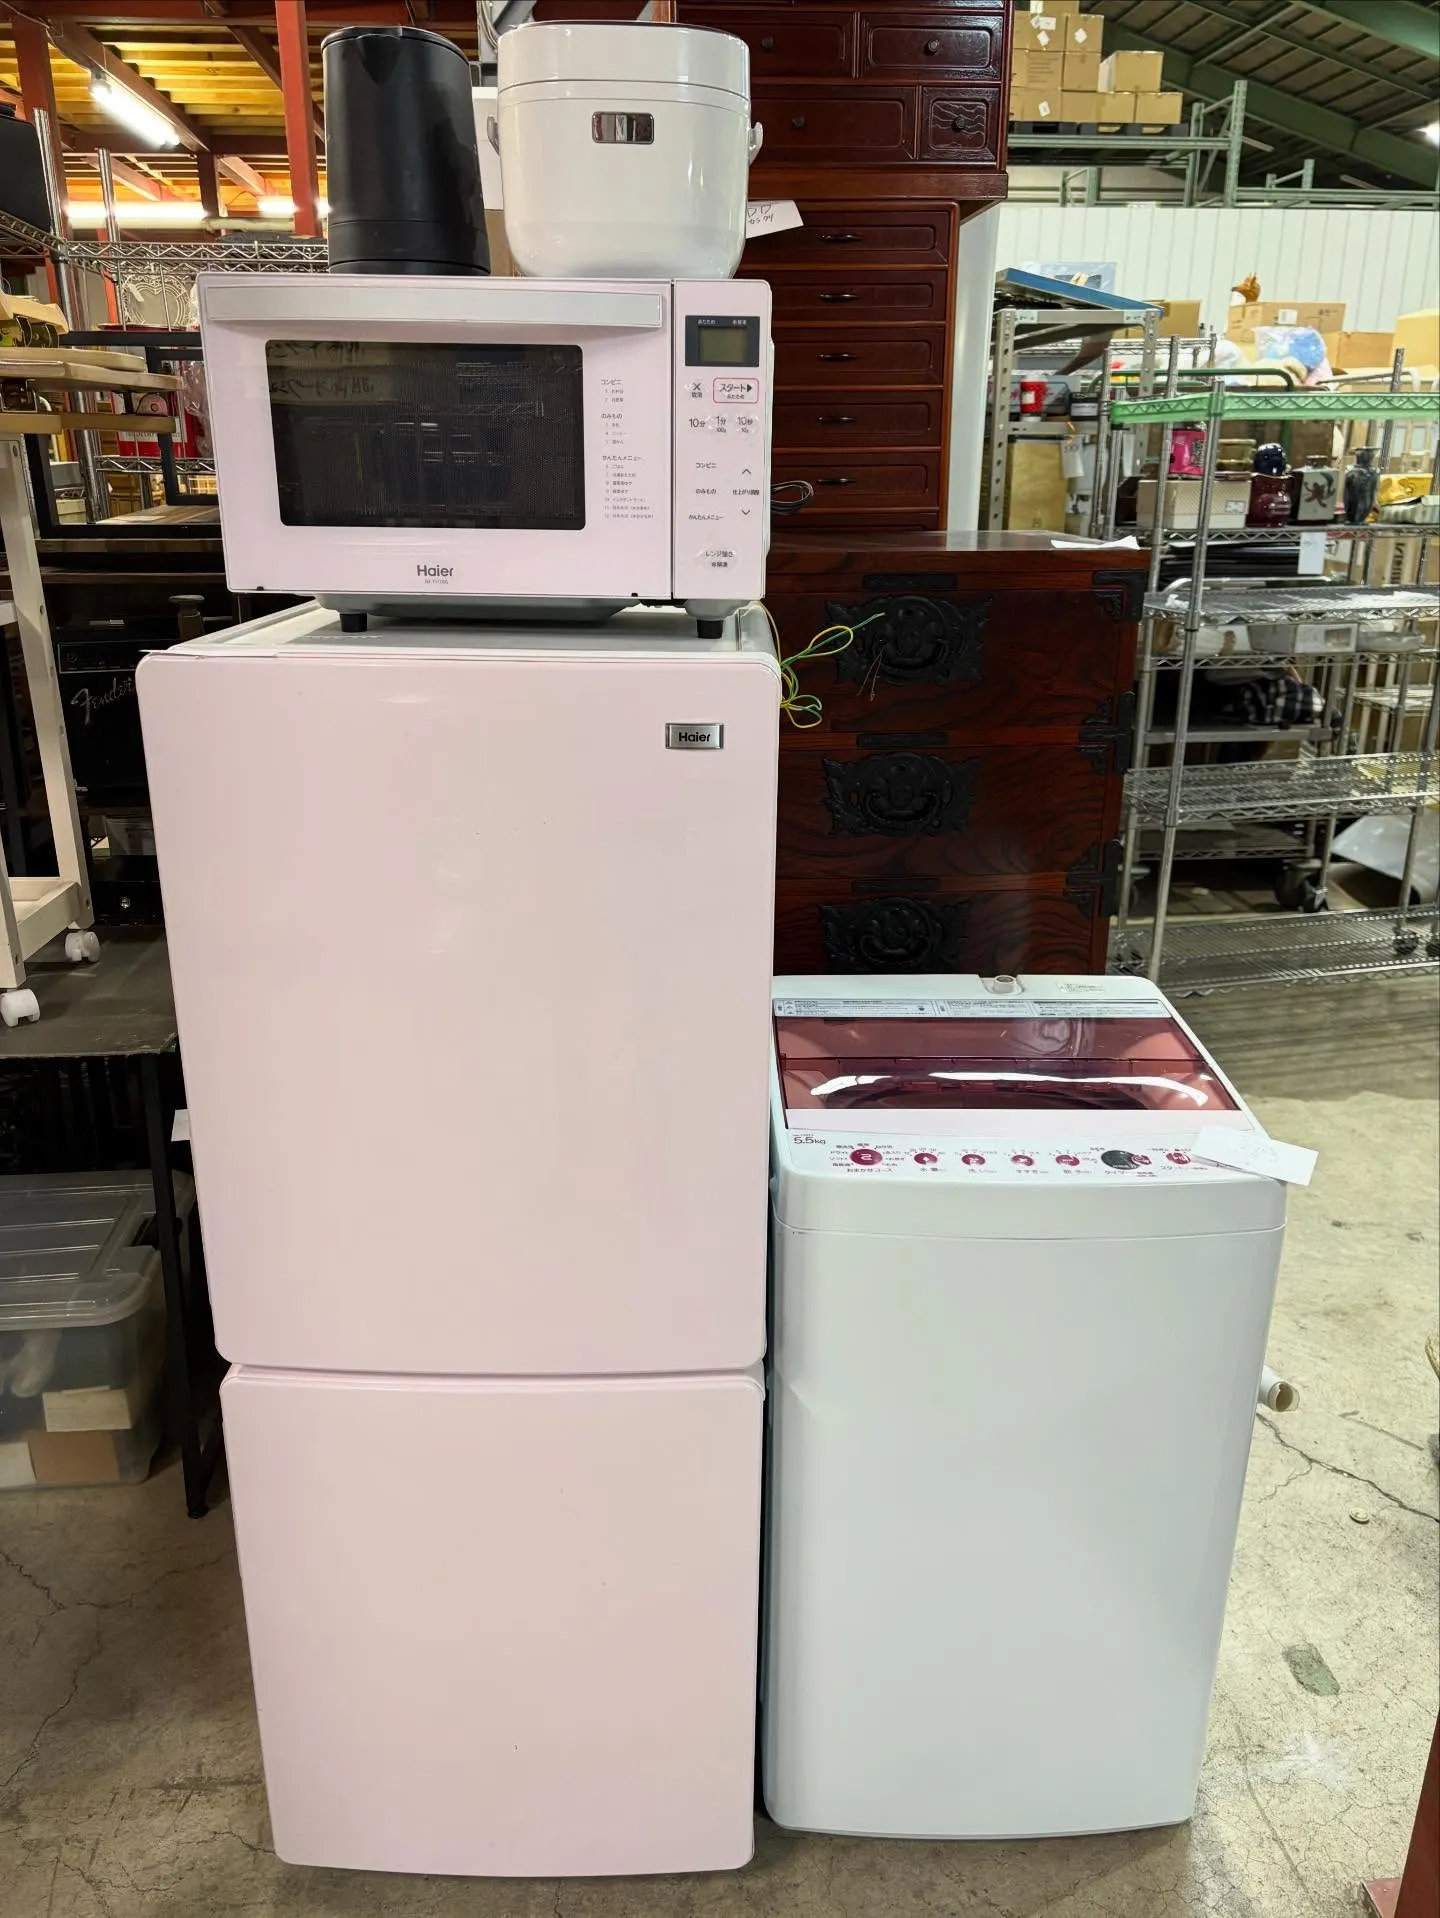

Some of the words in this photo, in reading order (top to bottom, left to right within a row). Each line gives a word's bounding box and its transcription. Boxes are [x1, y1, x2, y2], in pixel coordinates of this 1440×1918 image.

[719, 383, 747, 393] スタート
[689, 418, 706, 428] 10分
[716, 416, 727, 426] 1分
[416, 564, 454, 577] Haier
[678, 731, 711, 742] Haier
[793, 1136, 826, 1145] 5.5kg
